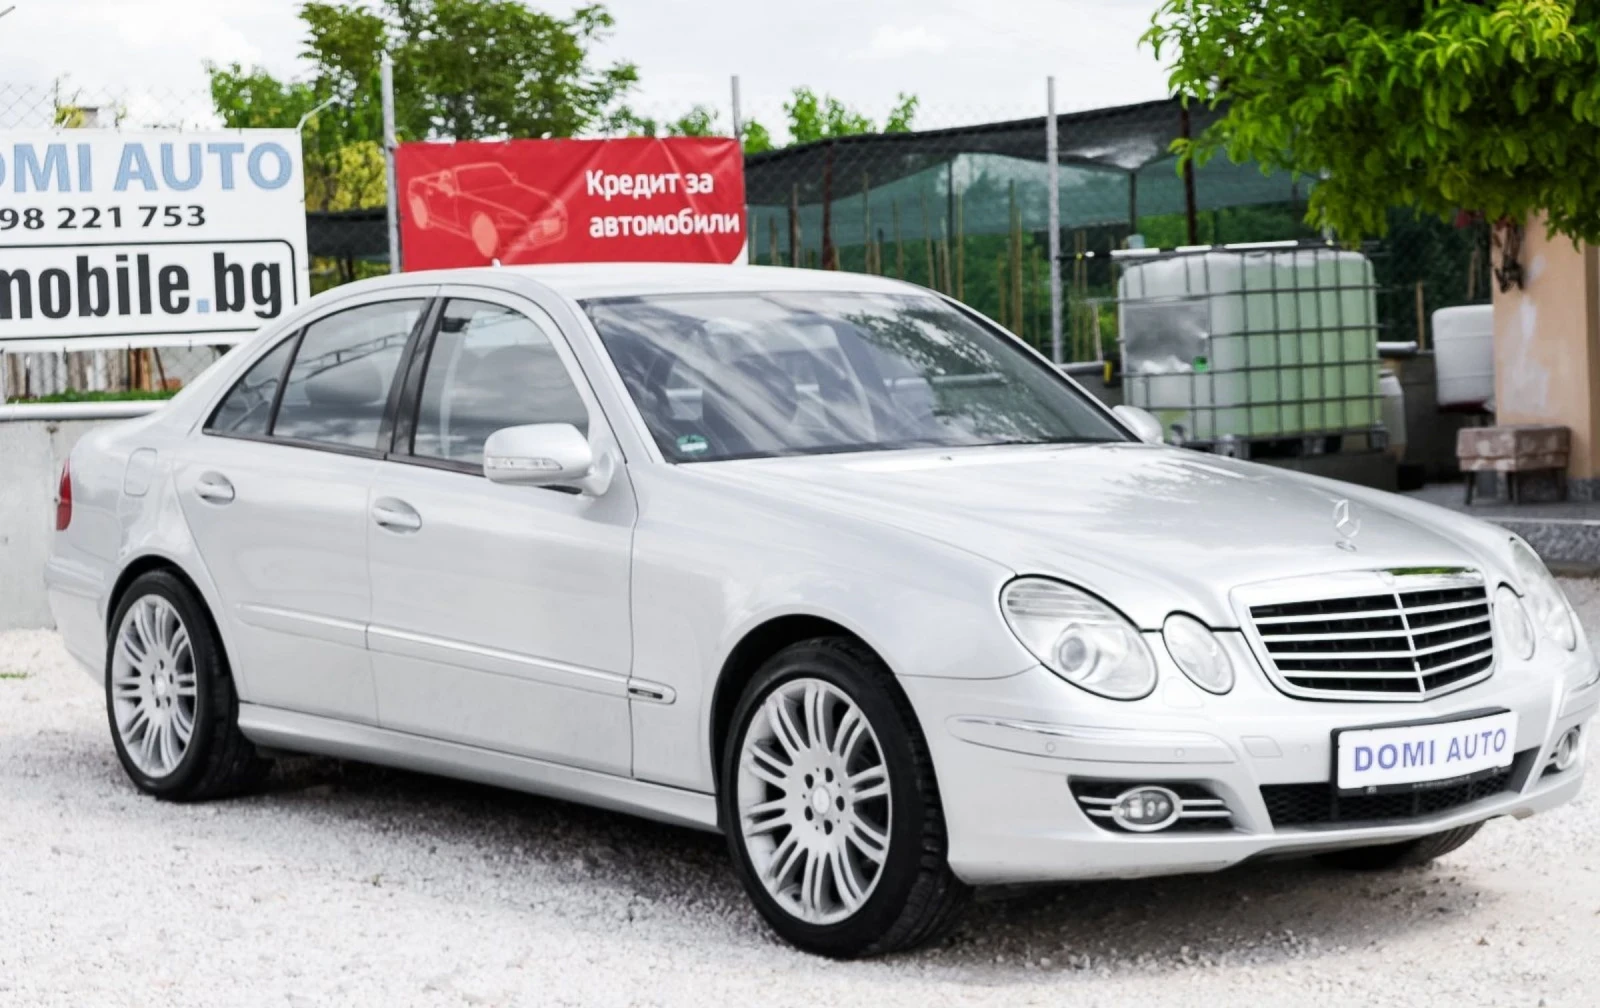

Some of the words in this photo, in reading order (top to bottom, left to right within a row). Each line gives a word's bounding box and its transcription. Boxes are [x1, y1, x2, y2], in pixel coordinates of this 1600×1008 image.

[0, 142, 93, 193] MI
[113, 142, 293, 192] AUTO
[586, 170, 679, 200] Кредит
[685, 173, 714, 195] за
[57, 206, 121, 229] 221
[138, 205, 206, 227] 753
[589, 208, 740, 238] автомобили
[1354, 740, 1435, 772] DOMI
[1446, 728, 1507, 763] AUTO
